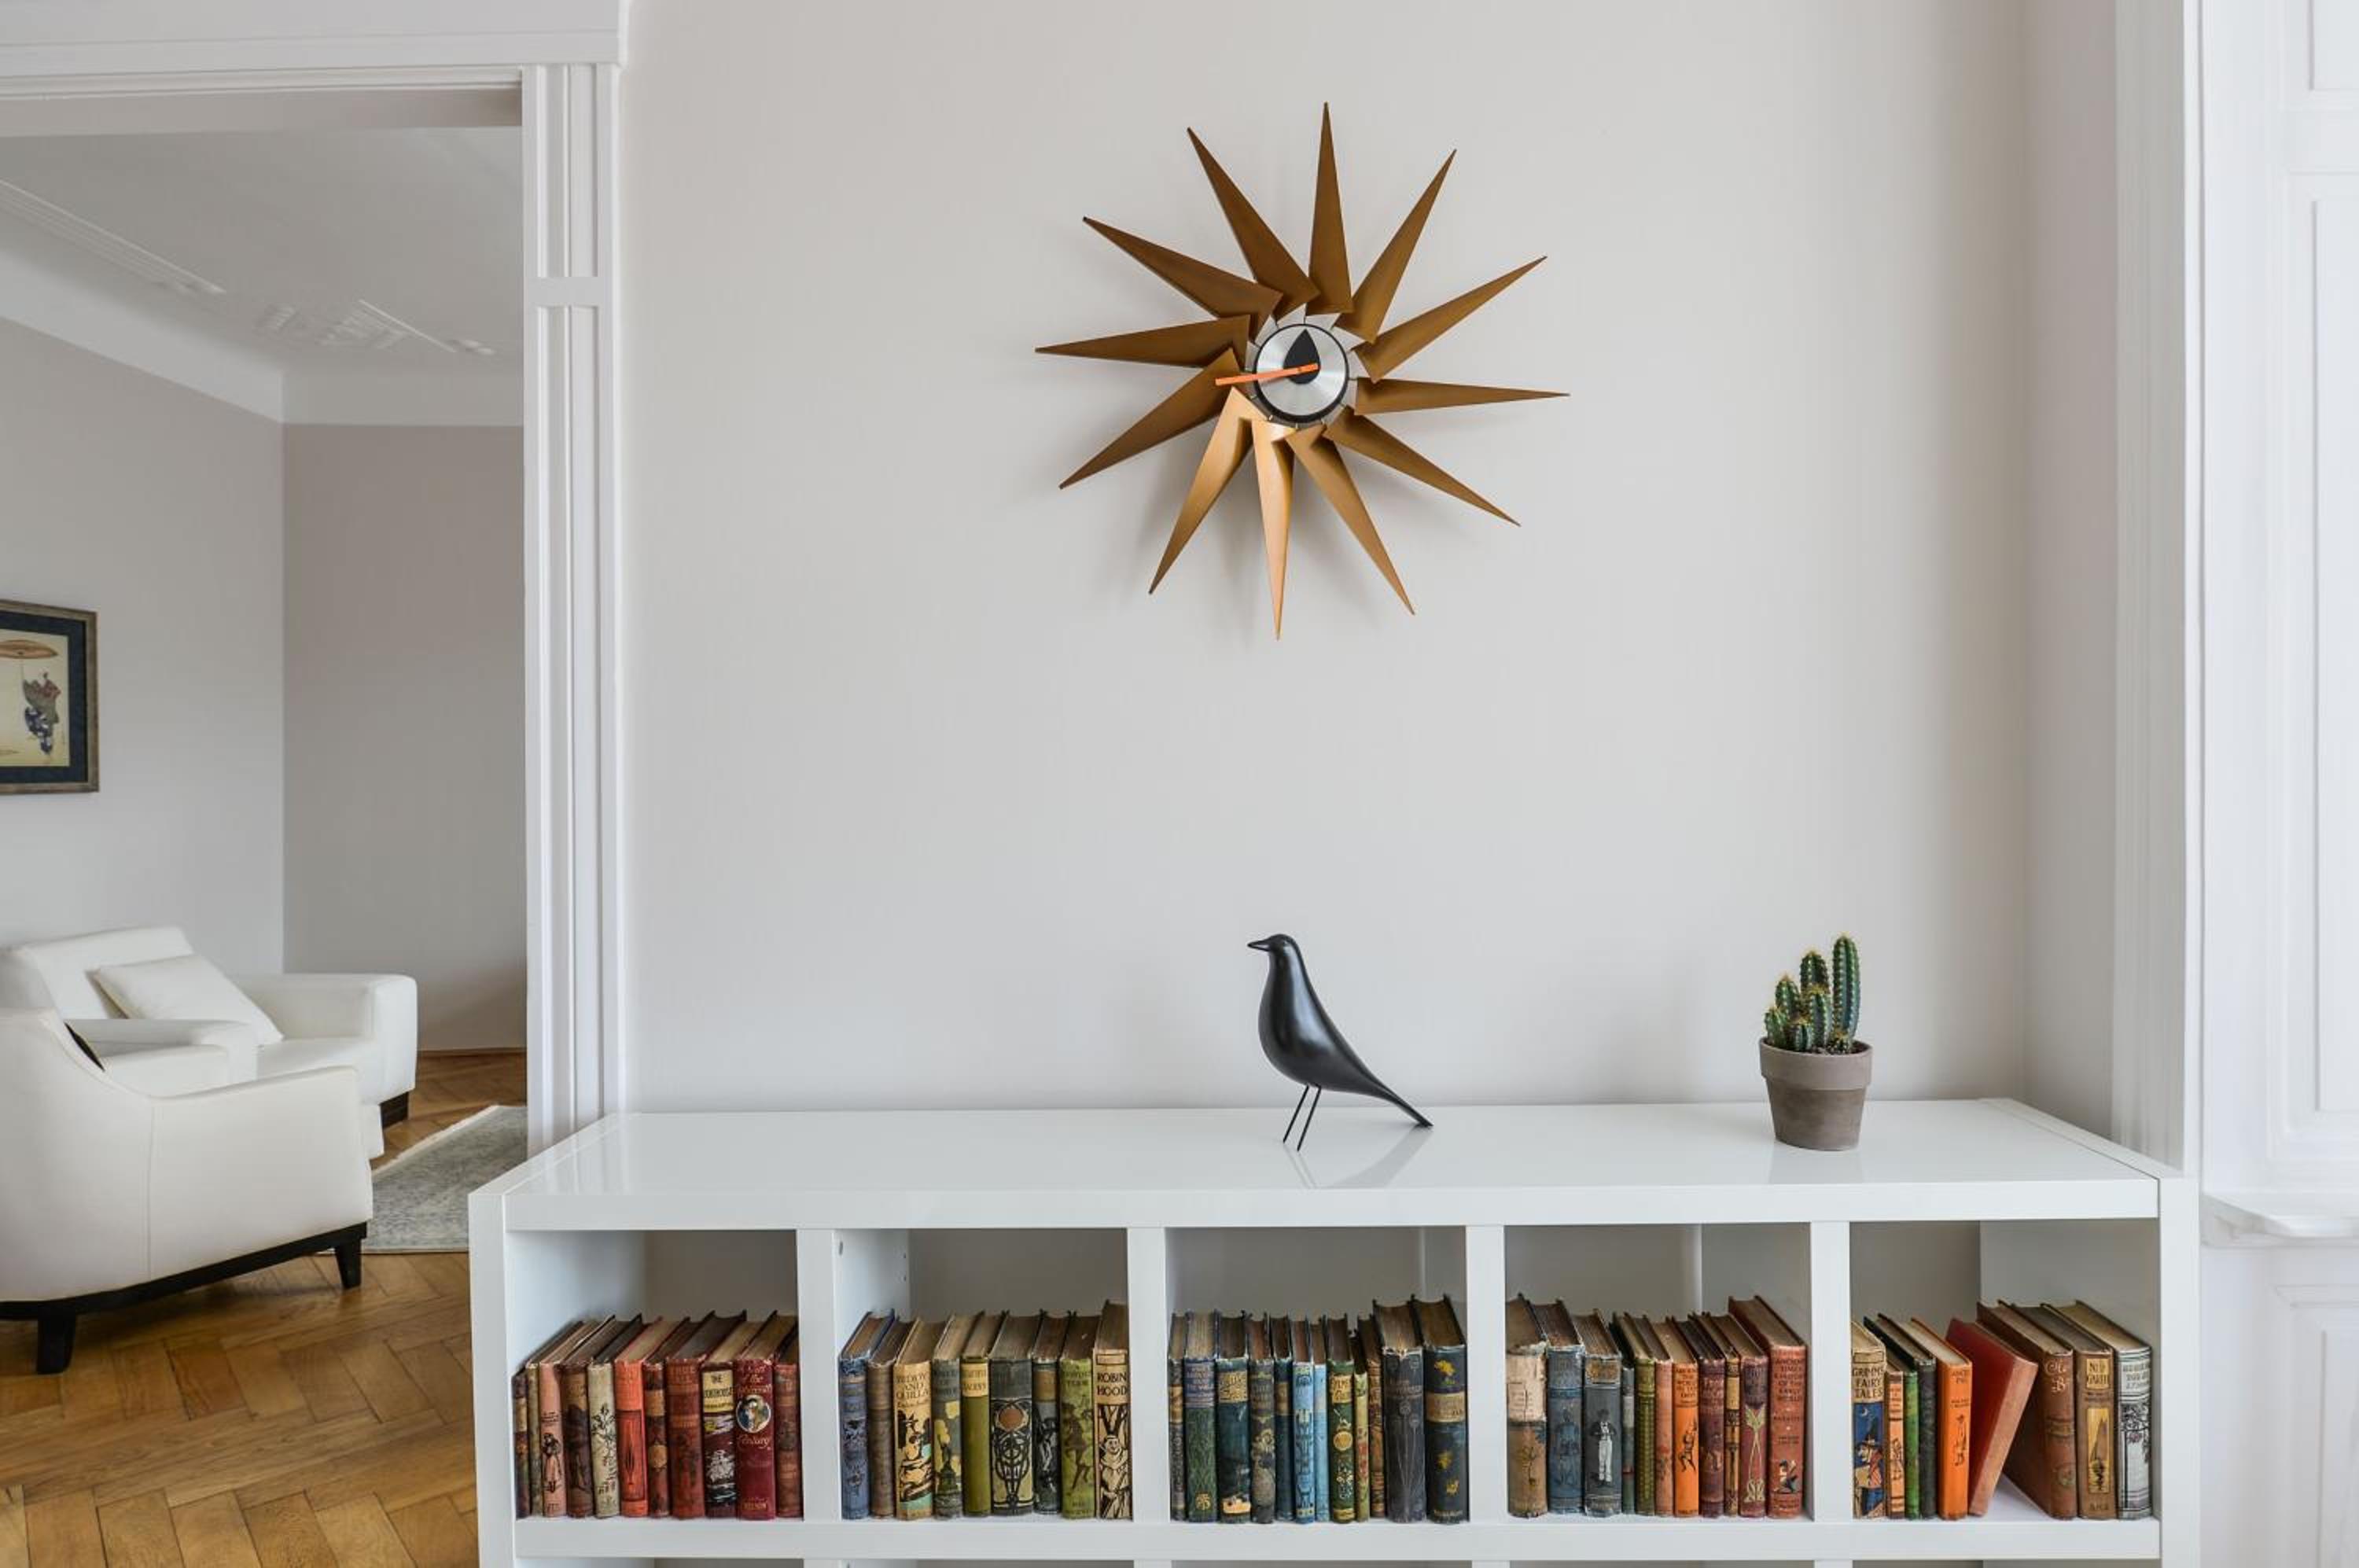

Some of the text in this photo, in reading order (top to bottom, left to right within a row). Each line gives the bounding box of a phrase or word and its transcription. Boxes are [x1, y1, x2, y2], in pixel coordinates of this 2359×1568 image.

[1096, 1371, 1128, 1383] ROBIN
[1855, 1377, 1881, 1388] FAIRY
[1096, 1385, 1128, 1397] HOOD
[1854, 1387, 1884, 1399] TALES
